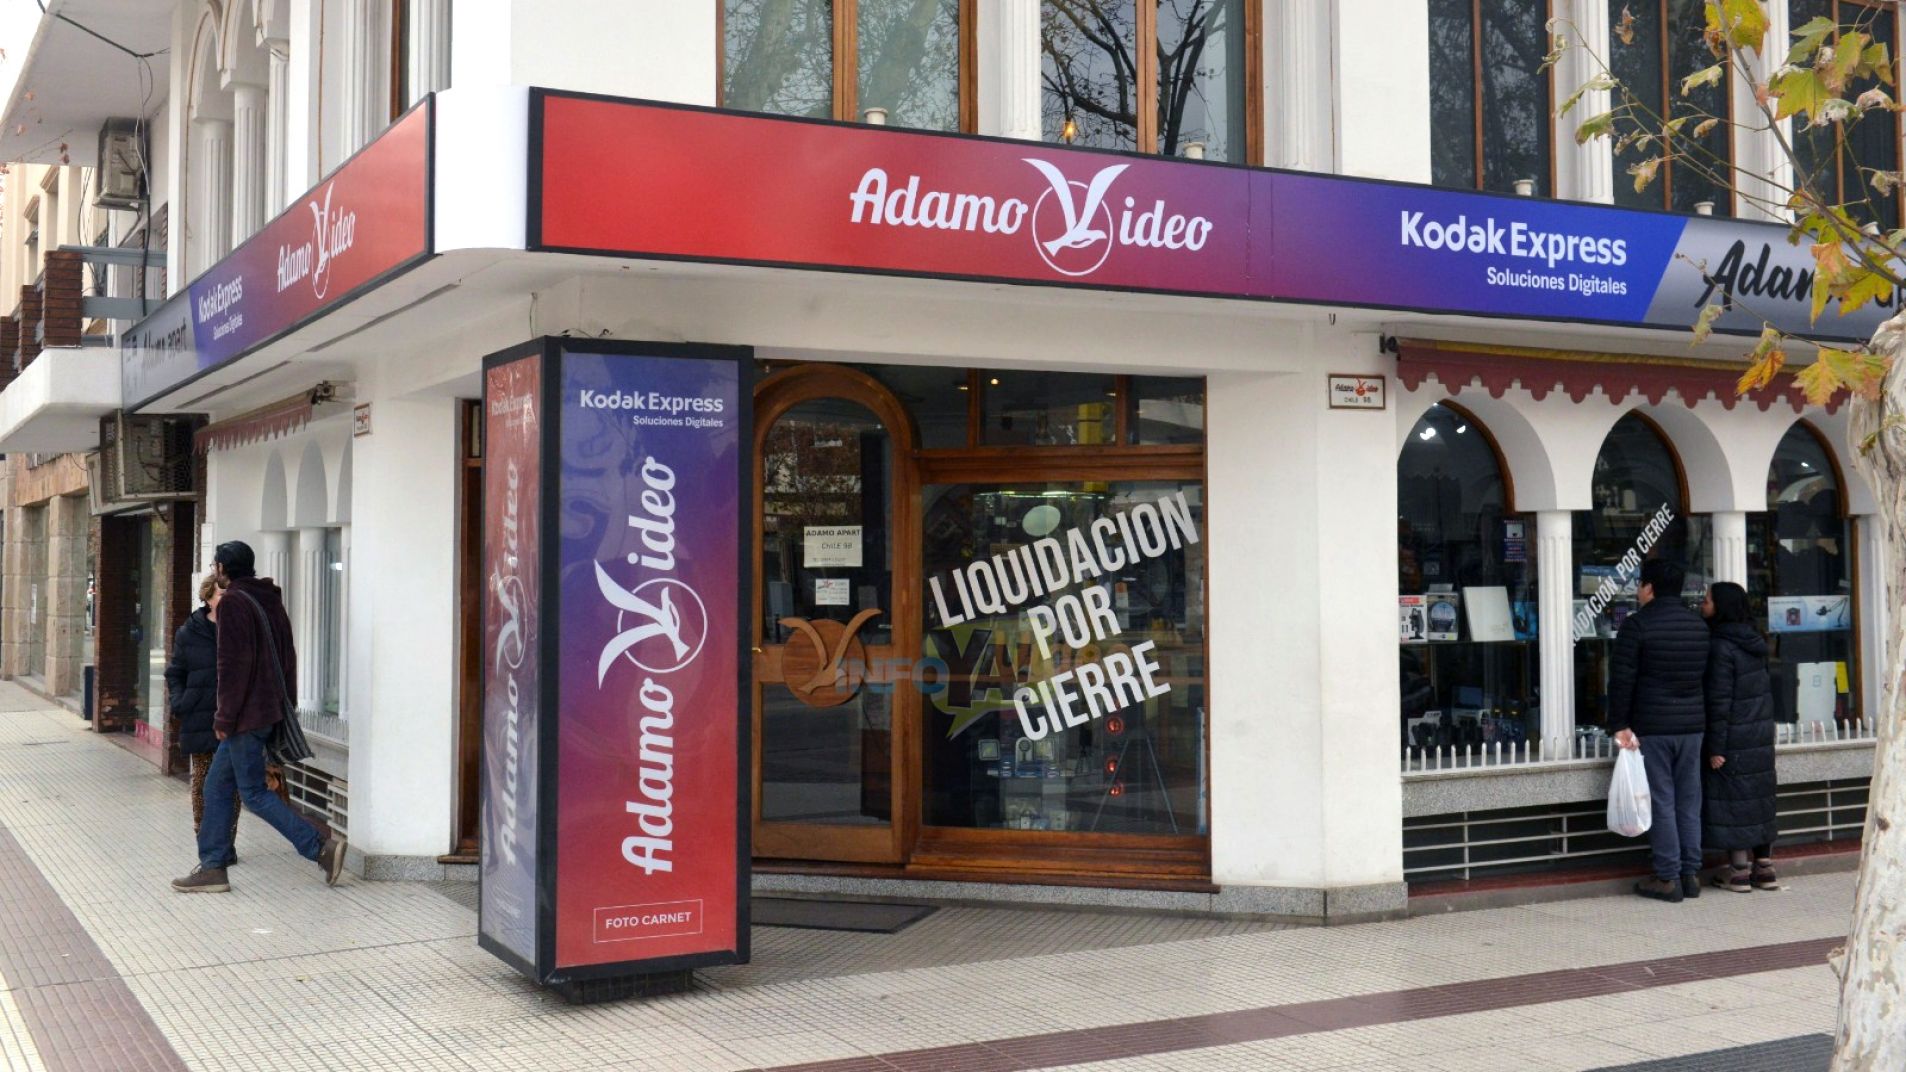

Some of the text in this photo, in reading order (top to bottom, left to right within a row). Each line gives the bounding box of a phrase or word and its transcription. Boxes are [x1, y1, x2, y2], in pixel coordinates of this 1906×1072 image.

[850, 168, 1028, 234] Adamo
[278, 238, 313, 292] Adamo
[1400, 210, 1627, 268] Kodak Express
[199, 275, 242, 324] Kodak Express
[1487, 267, 1627, 296] Soluciones Digitales
[1693, 240, 1843, 310] Ada
[580, 389, 724, 415] Kodak Express
[633, 415, 724, 429] Soluciones Digitales
[837, 529, 860, 537] APART
[929, 490, 1198, 628] LIQUIDACION
[1571, 576, 1619, 647] UIDACIÓN
[1615, 547, 1641, 581] POR
[1636, 502, 1674, 554] CIERRE
[1026, 584, 1121, 660] POR
[1013, 640, 1171, 741] CIERRE
[499, 673, 519, 865] Adamo
[621, 677, 674, 875] Adamo
[606, 911, 692, 929] FOTO CARNET
